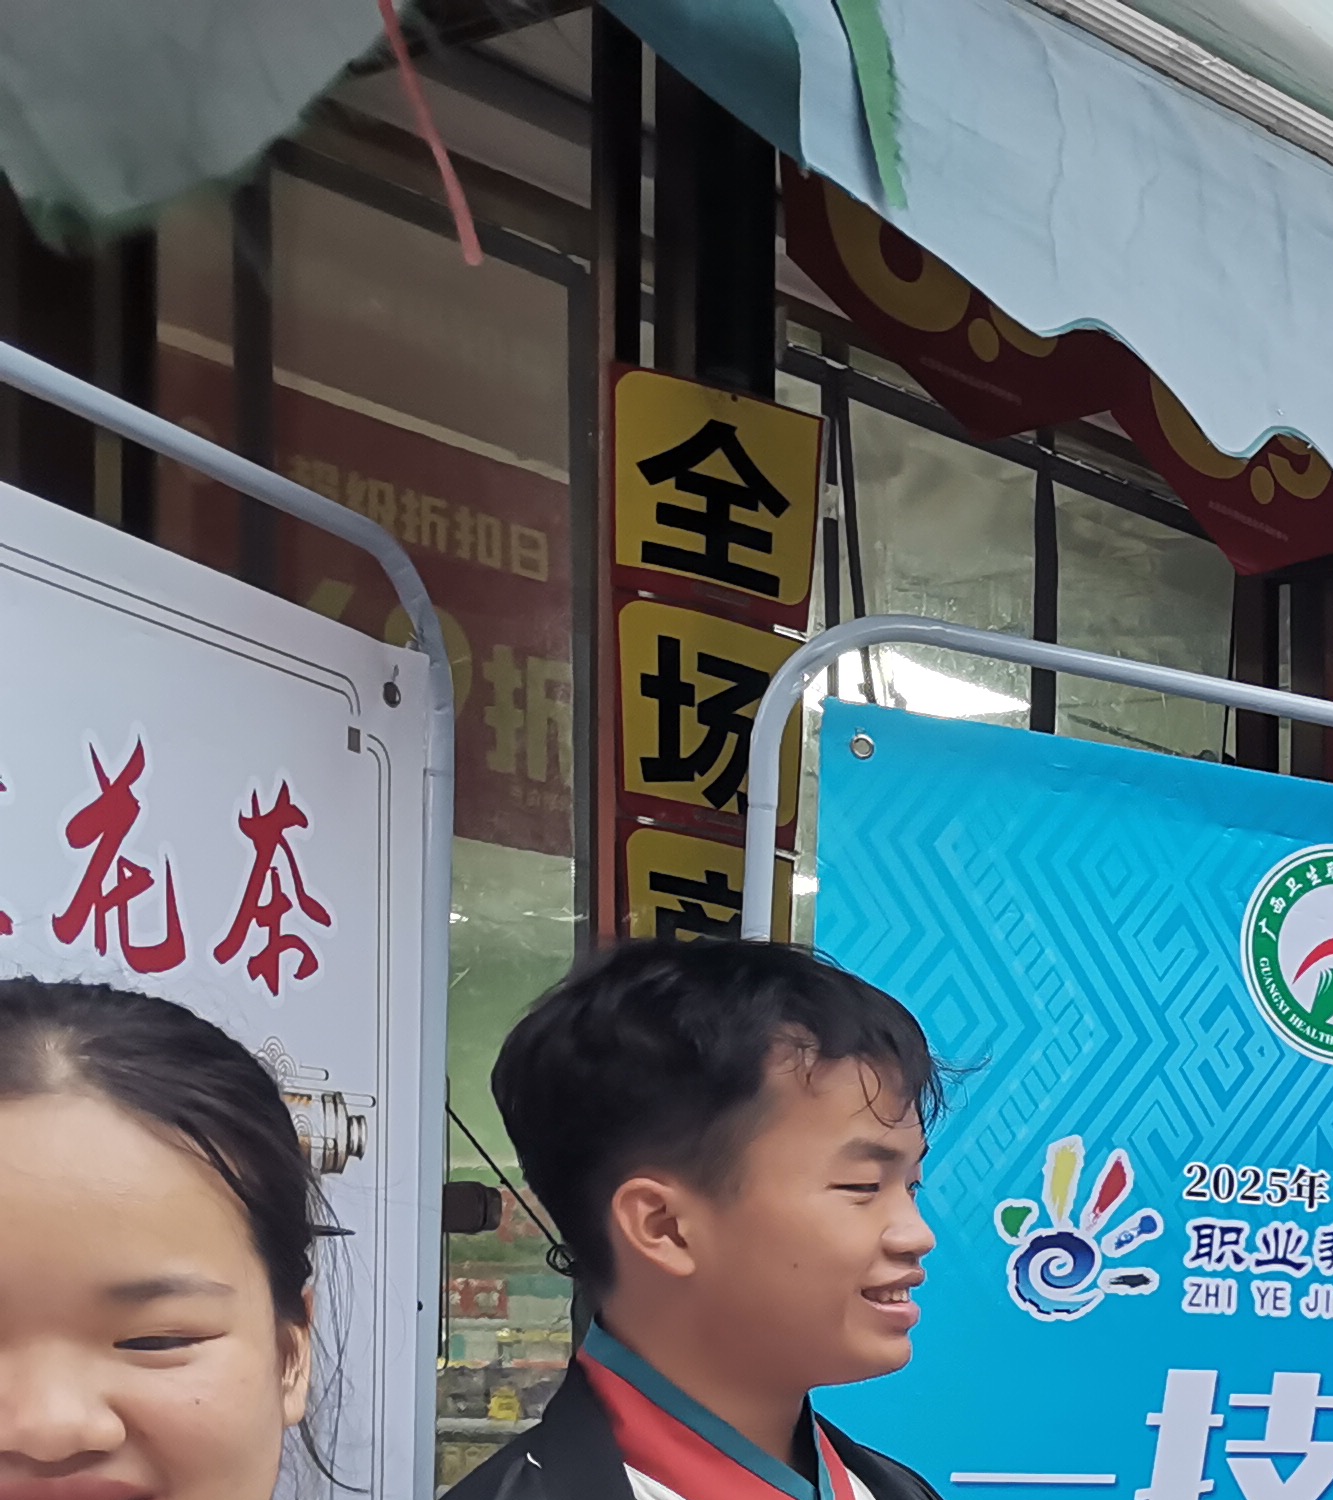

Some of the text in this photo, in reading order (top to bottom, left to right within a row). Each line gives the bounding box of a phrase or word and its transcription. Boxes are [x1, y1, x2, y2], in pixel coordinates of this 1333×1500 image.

[0, 733, 331, 997] 花茶
[1258, 957, 1292, 1016] GUANGXI
[1183, 1163, 1330, 1210] 2025年
[1187, 1282, 1234, 1309] ZHI
[1257, 1286, 1288, 1311] YE
